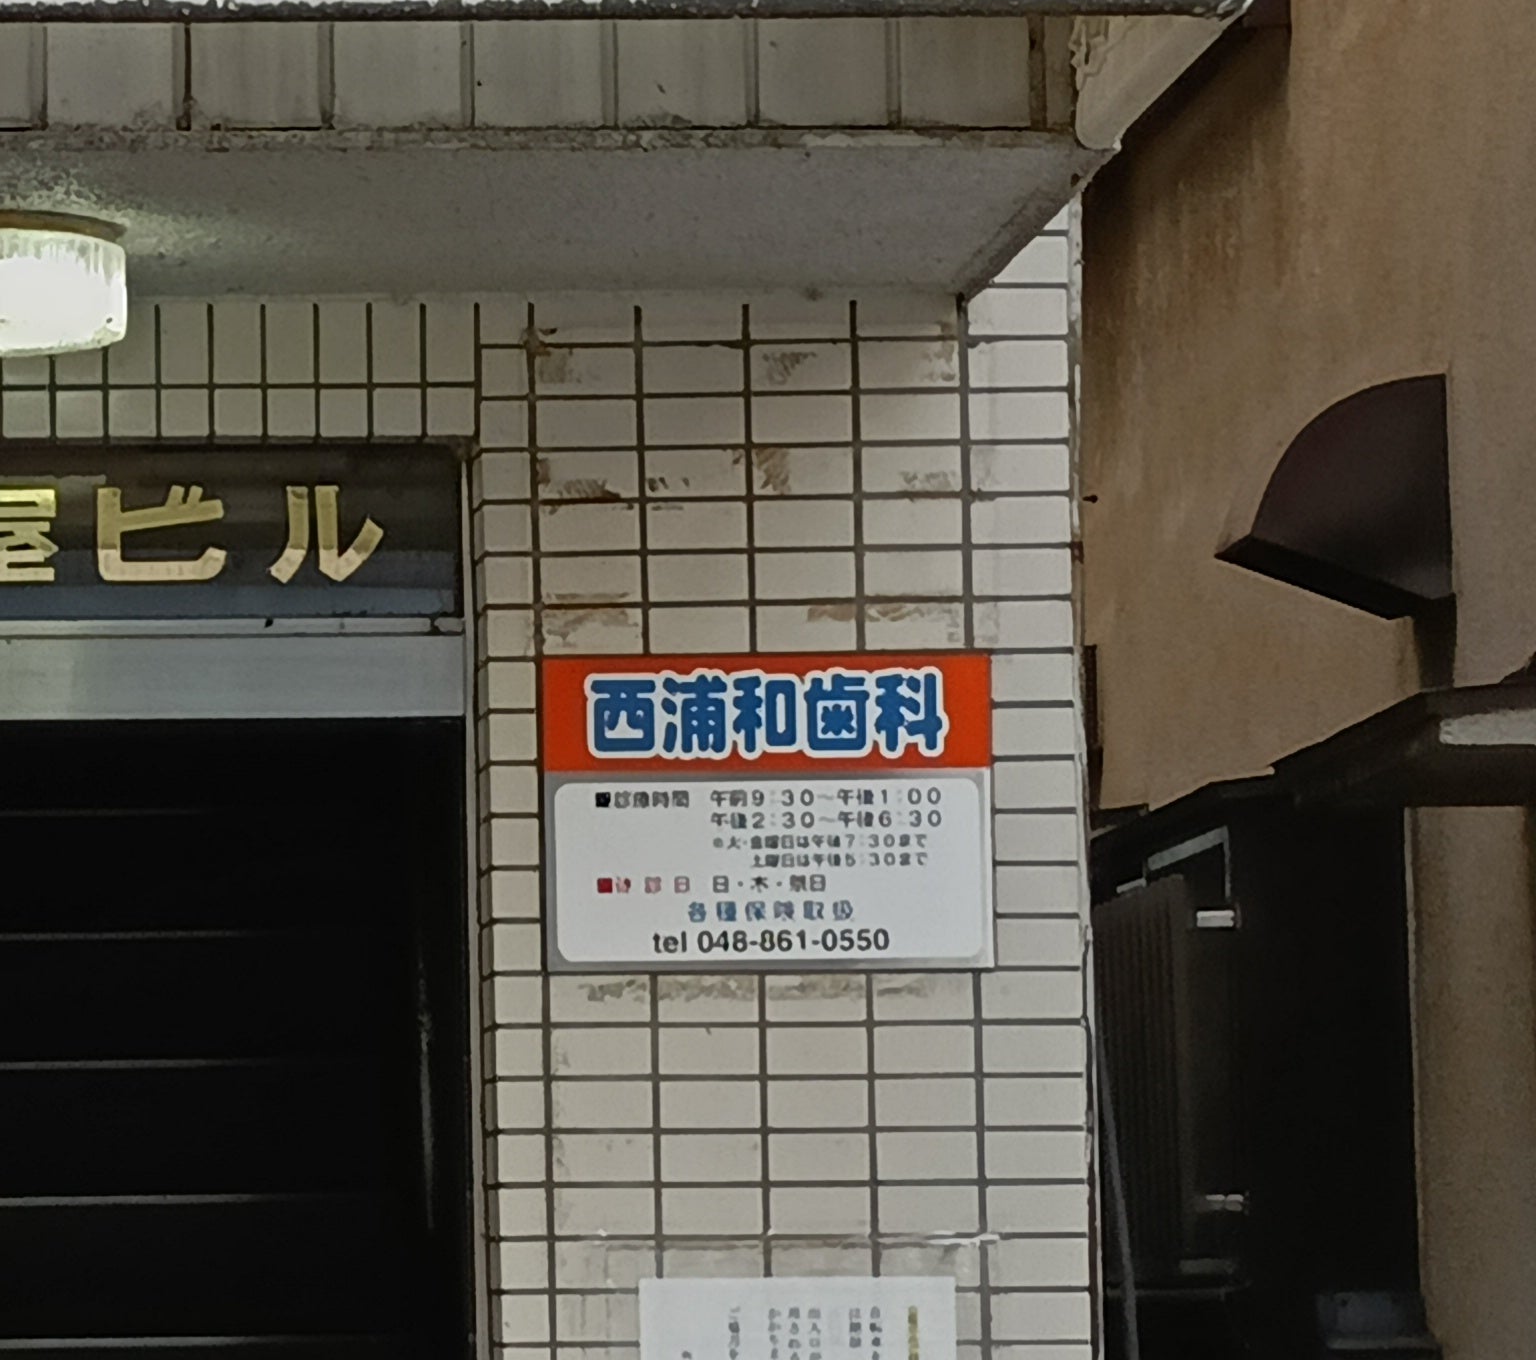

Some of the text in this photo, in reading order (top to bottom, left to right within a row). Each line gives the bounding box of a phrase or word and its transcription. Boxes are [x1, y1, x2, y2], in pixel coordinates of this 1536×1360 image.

[590, 672, 945, 754] 西浦和歯科
[653, 928, 890, 953] tel 048-861-0550
